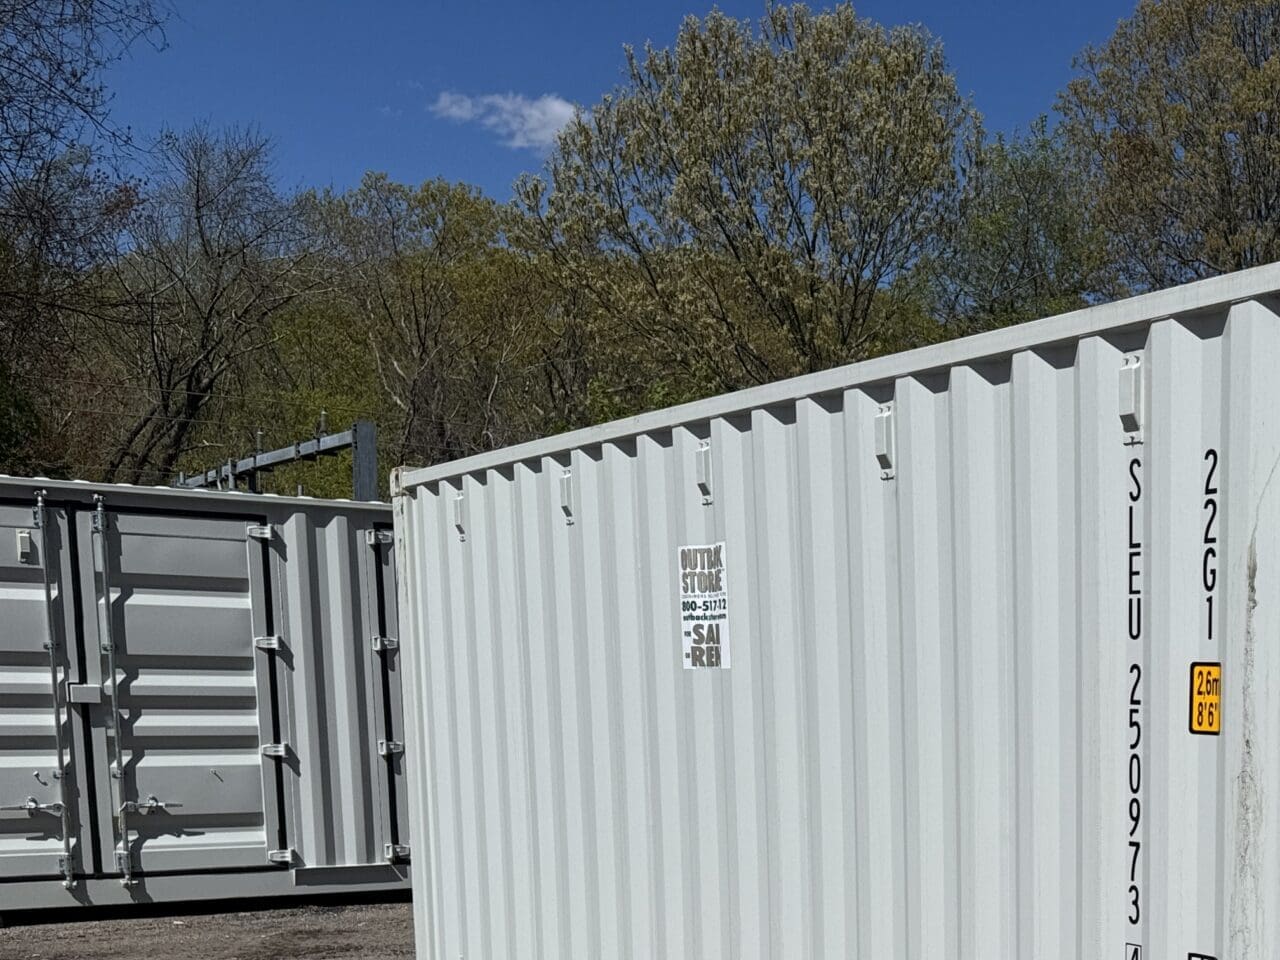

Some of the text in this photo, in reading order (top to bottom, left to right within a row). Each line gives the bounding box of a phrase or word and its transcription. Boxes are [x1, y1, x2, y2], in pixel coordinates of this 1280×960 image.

[1129, 458, 1142, 640] SLEU
[1203, 449, 1218, 640] 22G1
[1128, 664, 1142, 925] 250973
